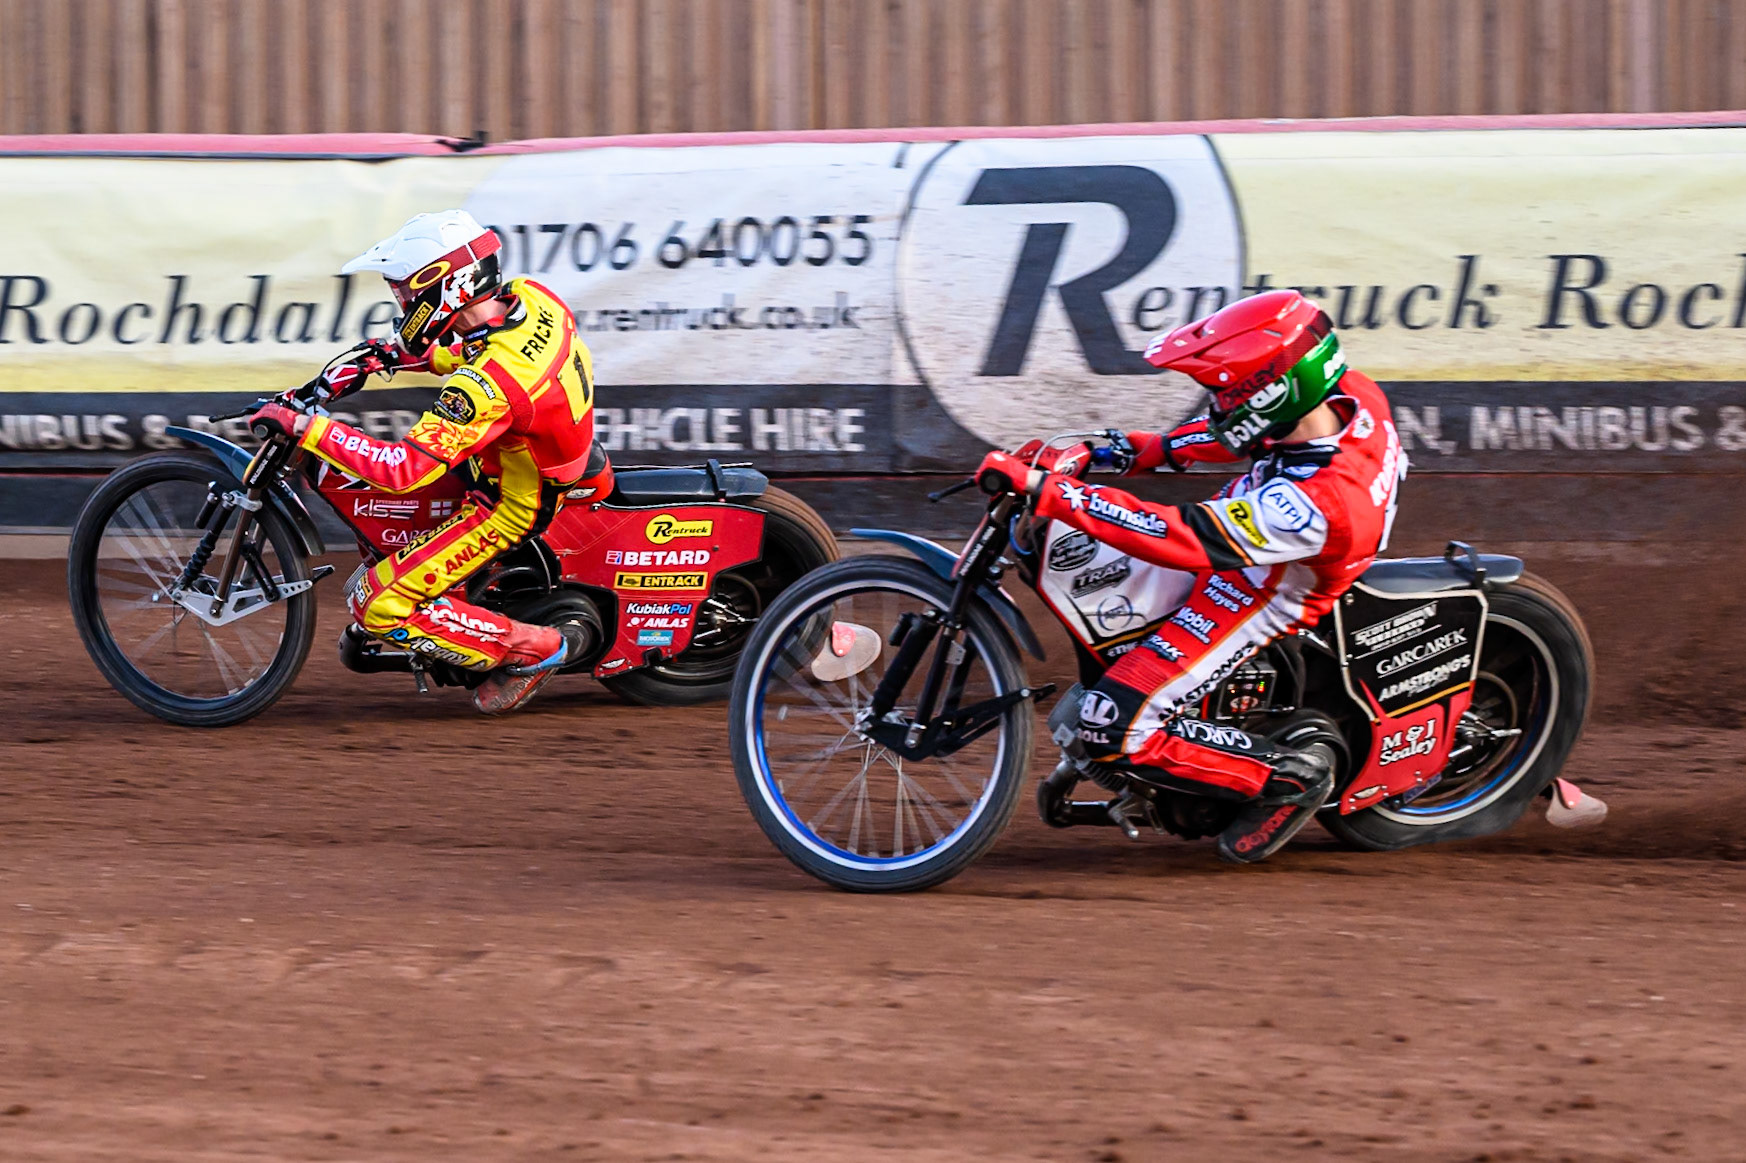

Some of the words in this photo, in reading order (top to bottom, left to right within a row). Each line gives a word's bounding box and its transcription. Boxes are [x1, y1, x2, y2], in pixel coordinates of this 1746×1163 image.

[657, 216, 875, 270] 640055
[0, 274, 399, 345] Rochdale
[593, 407, 744, 451] EHICLE
[751, 407, 865, 451] HIRE
[1468, 405, 1706, 451] MINIBUS
[1090, 491, 1168, 535] burnside
[1269, 488, 1304, 526] ATPI
[652, 521, 708, 538] Rentruck
[445, 529, 499, 575] ANLAS
[623, 549, 711, 566] BETARD
[643, 575, 700, 588] ENTRACK
[1208, 573, 1254, 606] Richard
[626, 602, 692, 615] KubiakPol
[1203, 586, 1240, 614] Hayes
[643, 617, 690, 628] ANLAS
[1149, 633, 1185, 661] RAK
[1375, 627, 1468, 676] GARCAREK
[1378, 736, 1437, 766] Sealey
[1382, 731, 1402, 751] M
[1405, 725, 1425, 742] &
[1425, 718, 1437, 739] J
